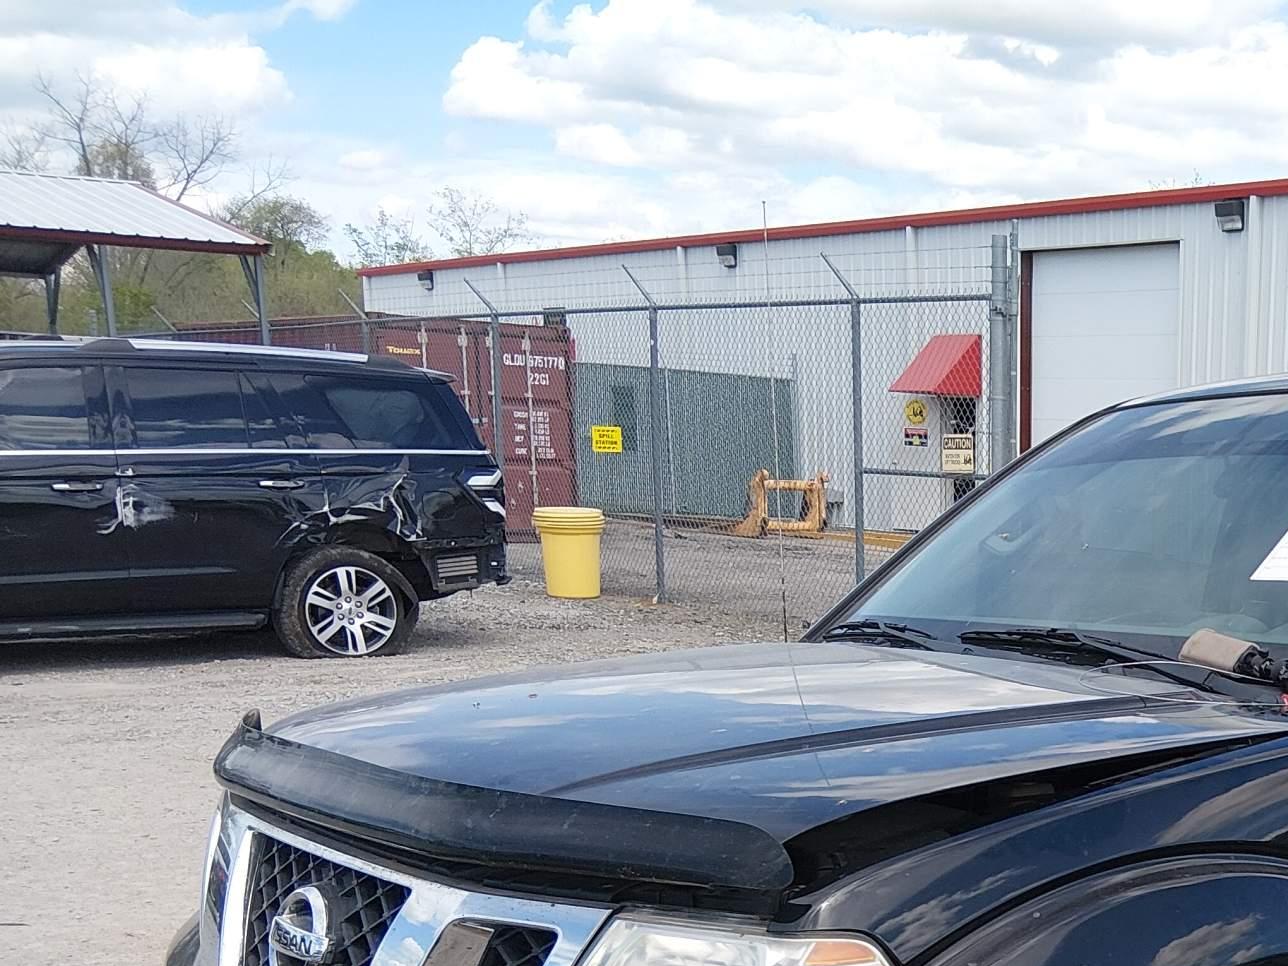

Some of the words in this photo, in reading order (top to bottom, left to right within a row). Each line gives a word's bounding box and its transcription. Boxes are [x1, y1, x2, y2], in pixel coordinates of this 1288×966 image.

[503, 353, 525, 366] GLDU
[529, 373, 550, 386] 22G1
[944, 438, 972, 449] CAUTION
